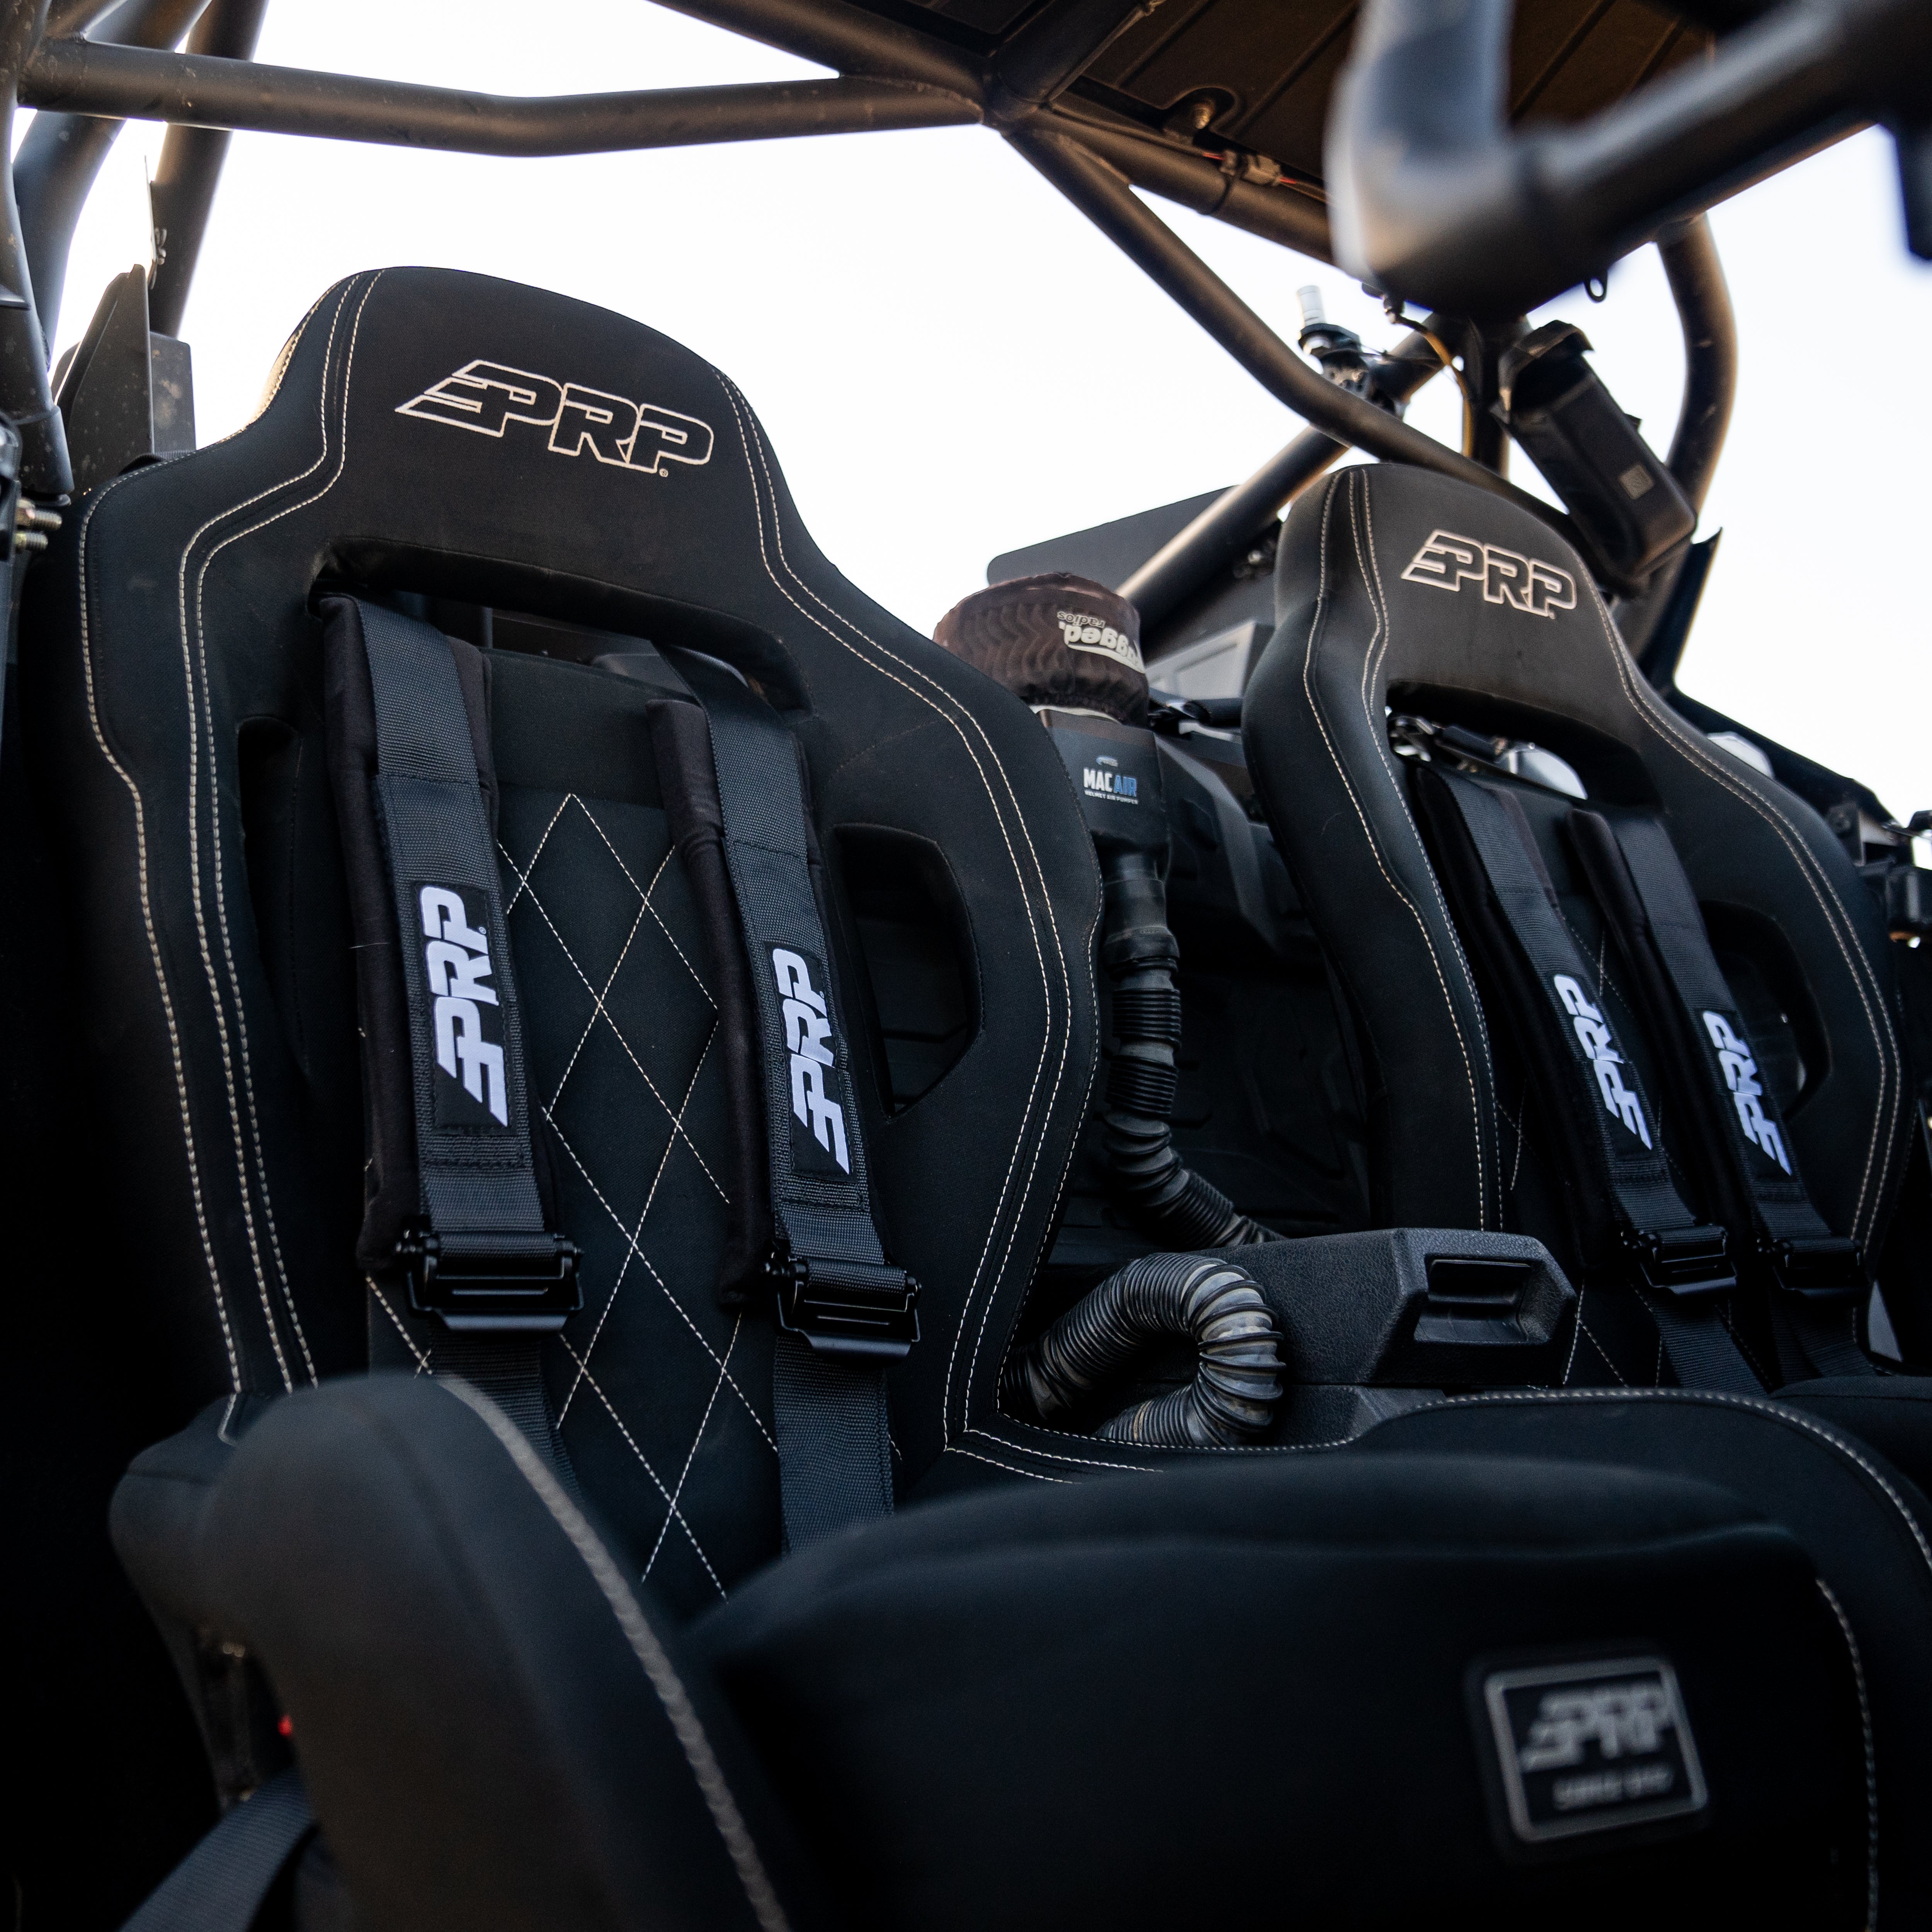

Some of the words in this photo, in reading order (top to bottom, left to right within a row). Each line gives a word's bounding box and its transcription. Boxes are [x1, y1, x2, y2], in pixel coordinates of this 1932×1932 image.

[1057, 611, 1105, 629] radios
[1083, 768, 1113, 793] MAC
[1113, 775, 1137, 797] AIR
[1084, 790, 1106, 799] HELMET
